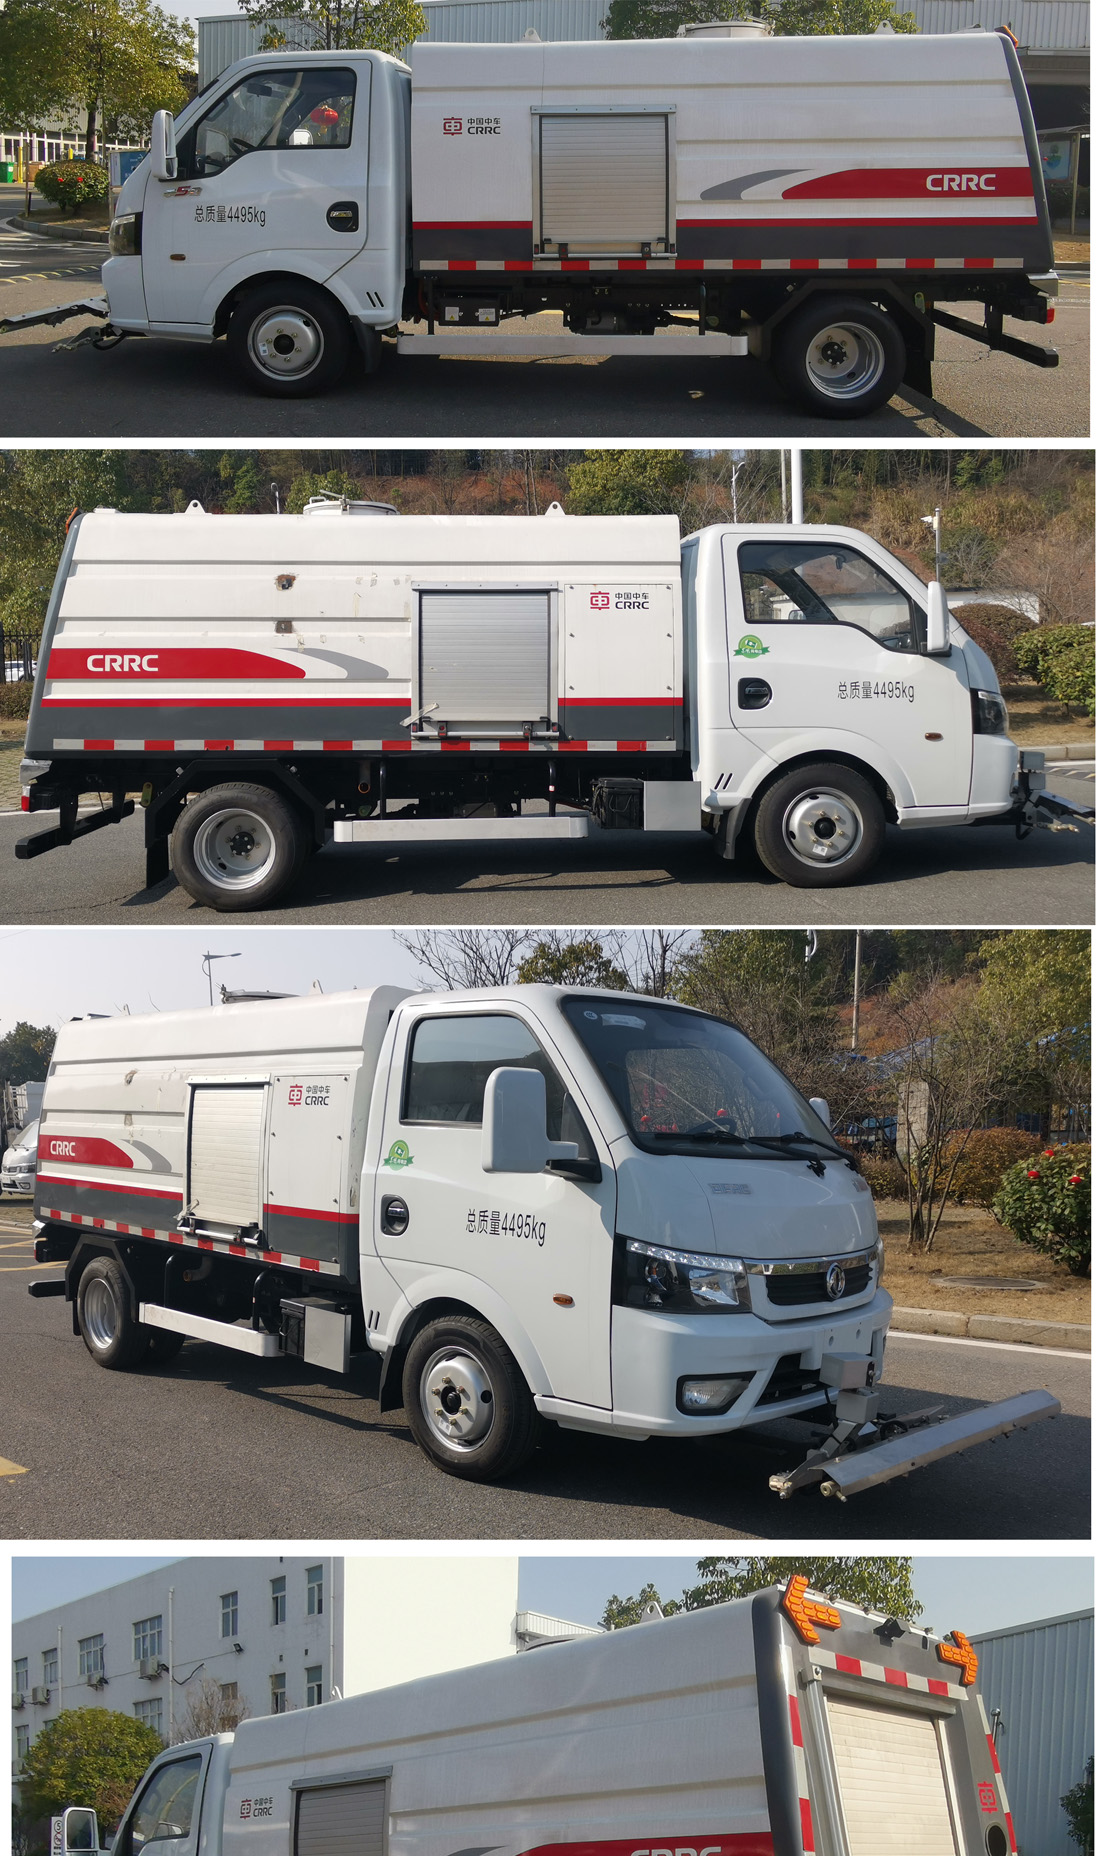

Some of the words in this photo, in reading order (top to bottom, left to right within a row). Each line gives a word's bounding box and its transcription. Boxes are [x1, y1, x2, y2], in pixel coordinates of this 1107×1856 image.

[467, 117, 501, 125] 中国中车
[467, 126, 501, 135] CRRC
[926, 174, 996, 191] CRRC
[194, 205, 266, 227] 总质量4495kg
[615, 592, 649, 600] 中国中车
[615, 601, 649, 610] CRRC
[86, 654, 159, 672] CRRC
[837, 681, 915, 703] 总质量4495kg
[305, 1085, 330, 1094] 中国中车
[304, 1095, 330, 1106] CRRC
[50, 1140, 76, 1157] CRRC
[465, 1208, 546, 1247] 总质量4495kg
[253, 1806, 273, 1817] CRRC
